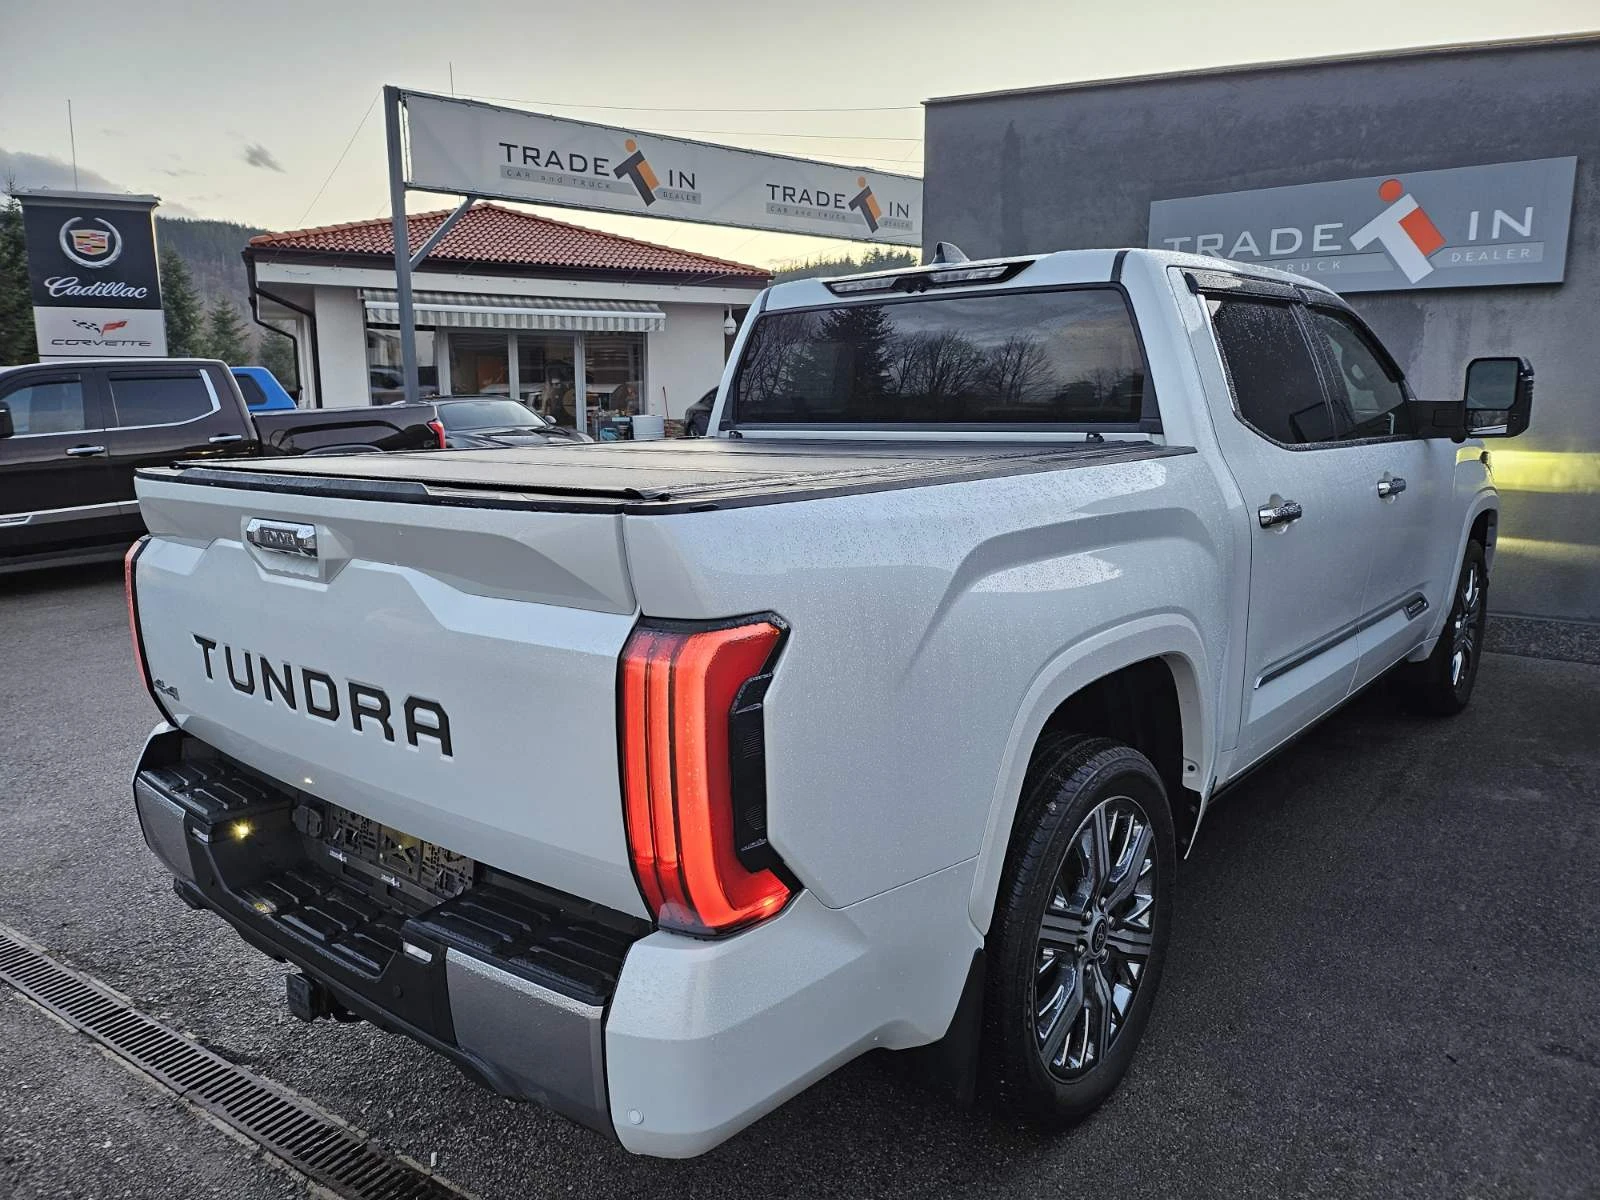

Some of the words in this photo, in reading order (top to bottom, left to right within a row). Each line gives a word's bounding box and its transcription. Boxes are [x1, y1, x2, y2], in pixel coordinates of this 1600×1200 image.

[498, 142, 611, 177] TRADE
[668, 168, 697, 191] IN
[506, 168, 531, 179] CAR
[572, 178, 611, 189] TRUCK
[766, 183, 846, 210] TRADE
[889, 201, 910, 219] IN
[1163, 222, 1344, 259] TRADE
[1468, 206, 1535, 242] IN
[1451, 248, 1532, 264] DEALER
[44, 276, 148, 299] Cadillac
[51, 338, 152, 347] CORVETTE
[192, 633, 454, 758] TUNDRA
